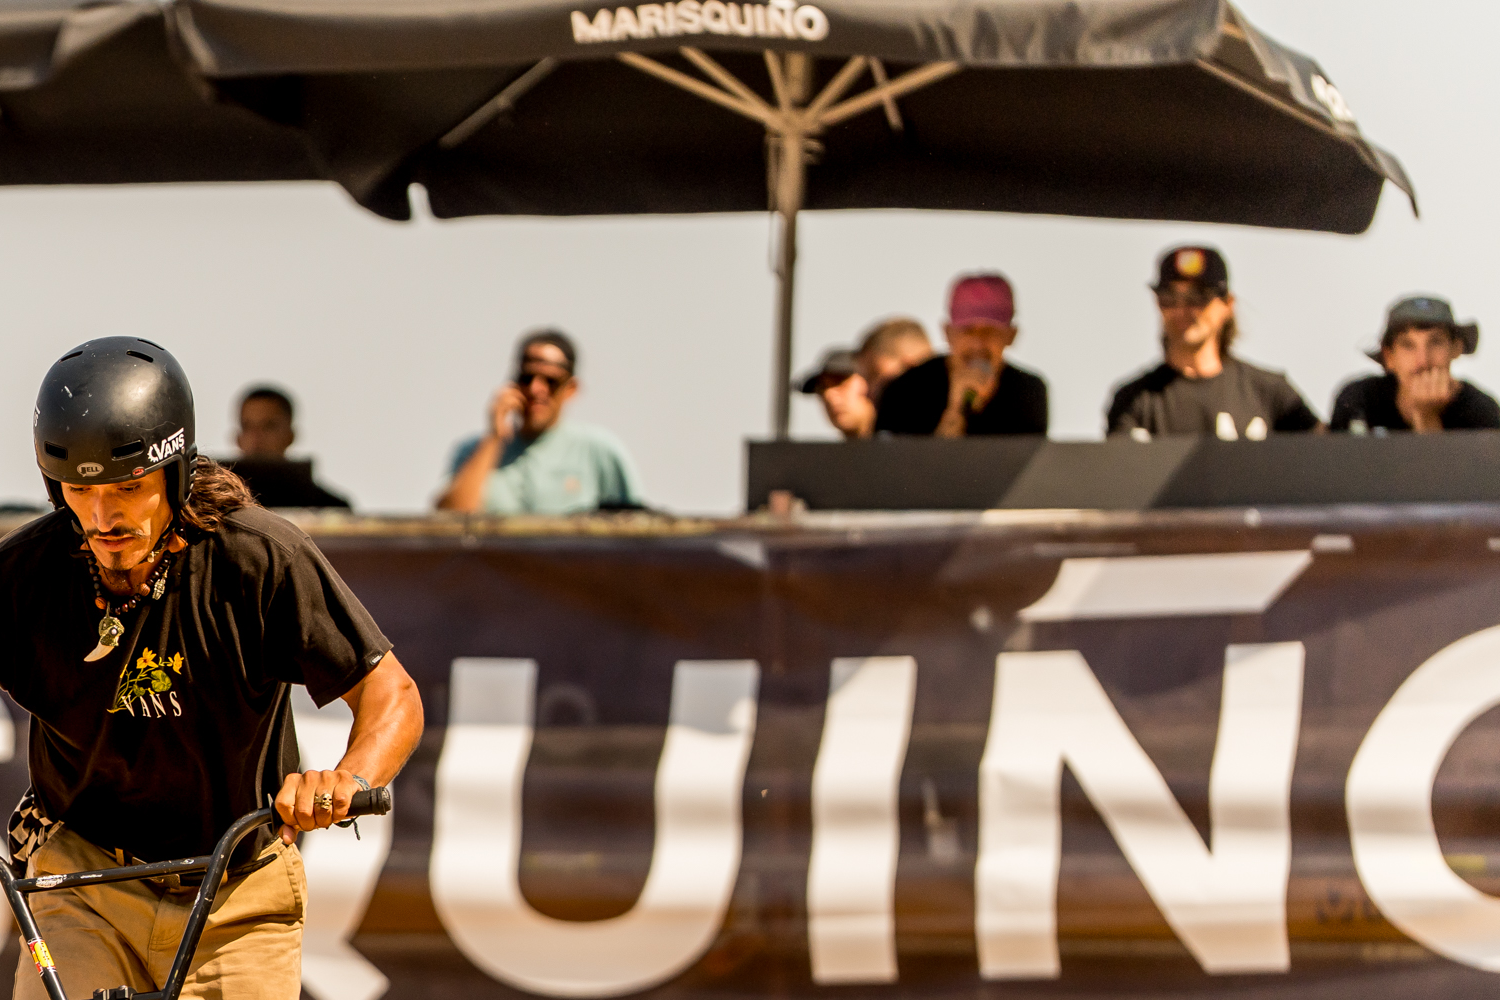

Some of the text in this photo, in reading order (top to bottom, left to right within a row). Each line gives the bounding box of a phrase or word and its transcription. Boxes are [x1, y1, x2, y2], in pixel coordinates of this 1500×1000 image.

[571, 0, 830, 43] MARISQUIÑO
[150, 428, 185, 462] VANS
[121, 691, 182, 718] VANS
